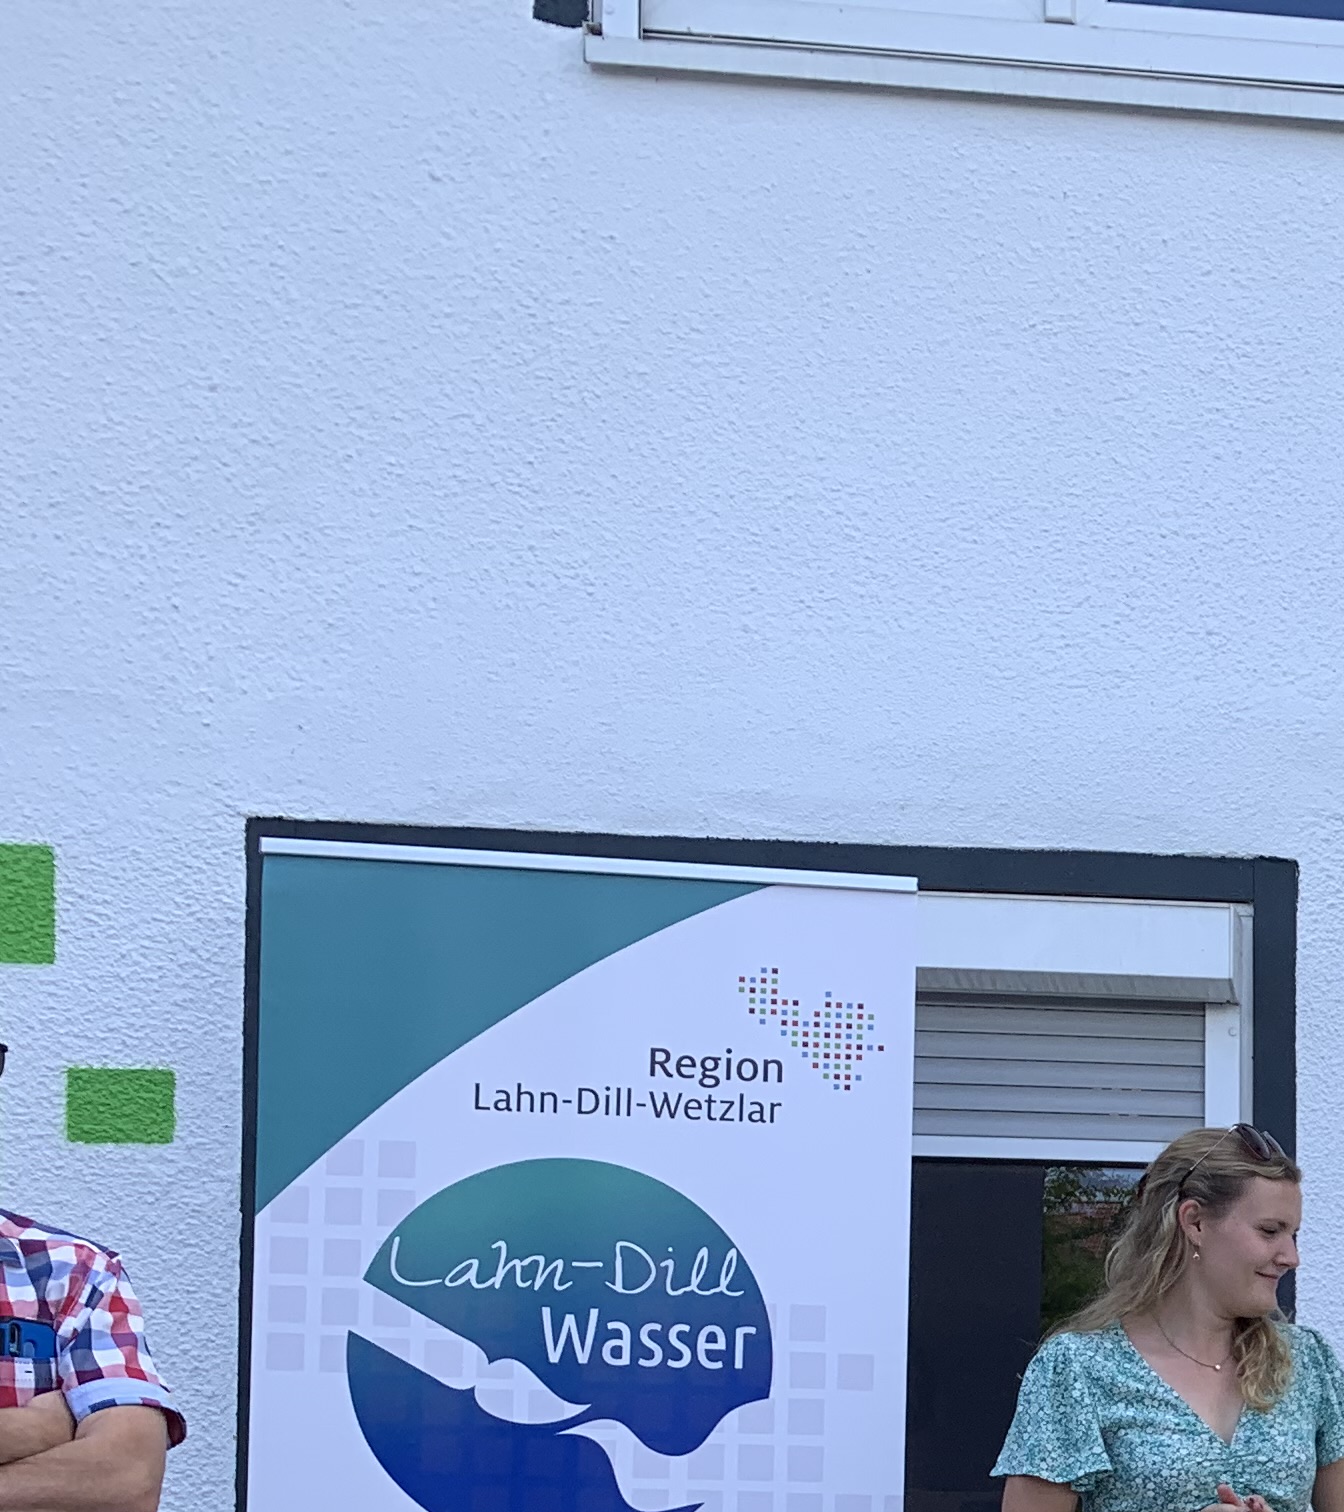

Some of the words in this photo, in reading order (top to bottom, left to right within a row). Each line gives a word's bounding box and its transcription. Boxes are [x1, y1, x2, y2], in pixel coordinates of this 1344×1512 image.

[650, 1047, 784, 1089] Region
[474, 1083, 782, 1125] Lahn-Dill-Wetzlar
[390, 1236, 745, 1297] Lahn-Dill
[541, 1306, 757, 1370] Wasser
